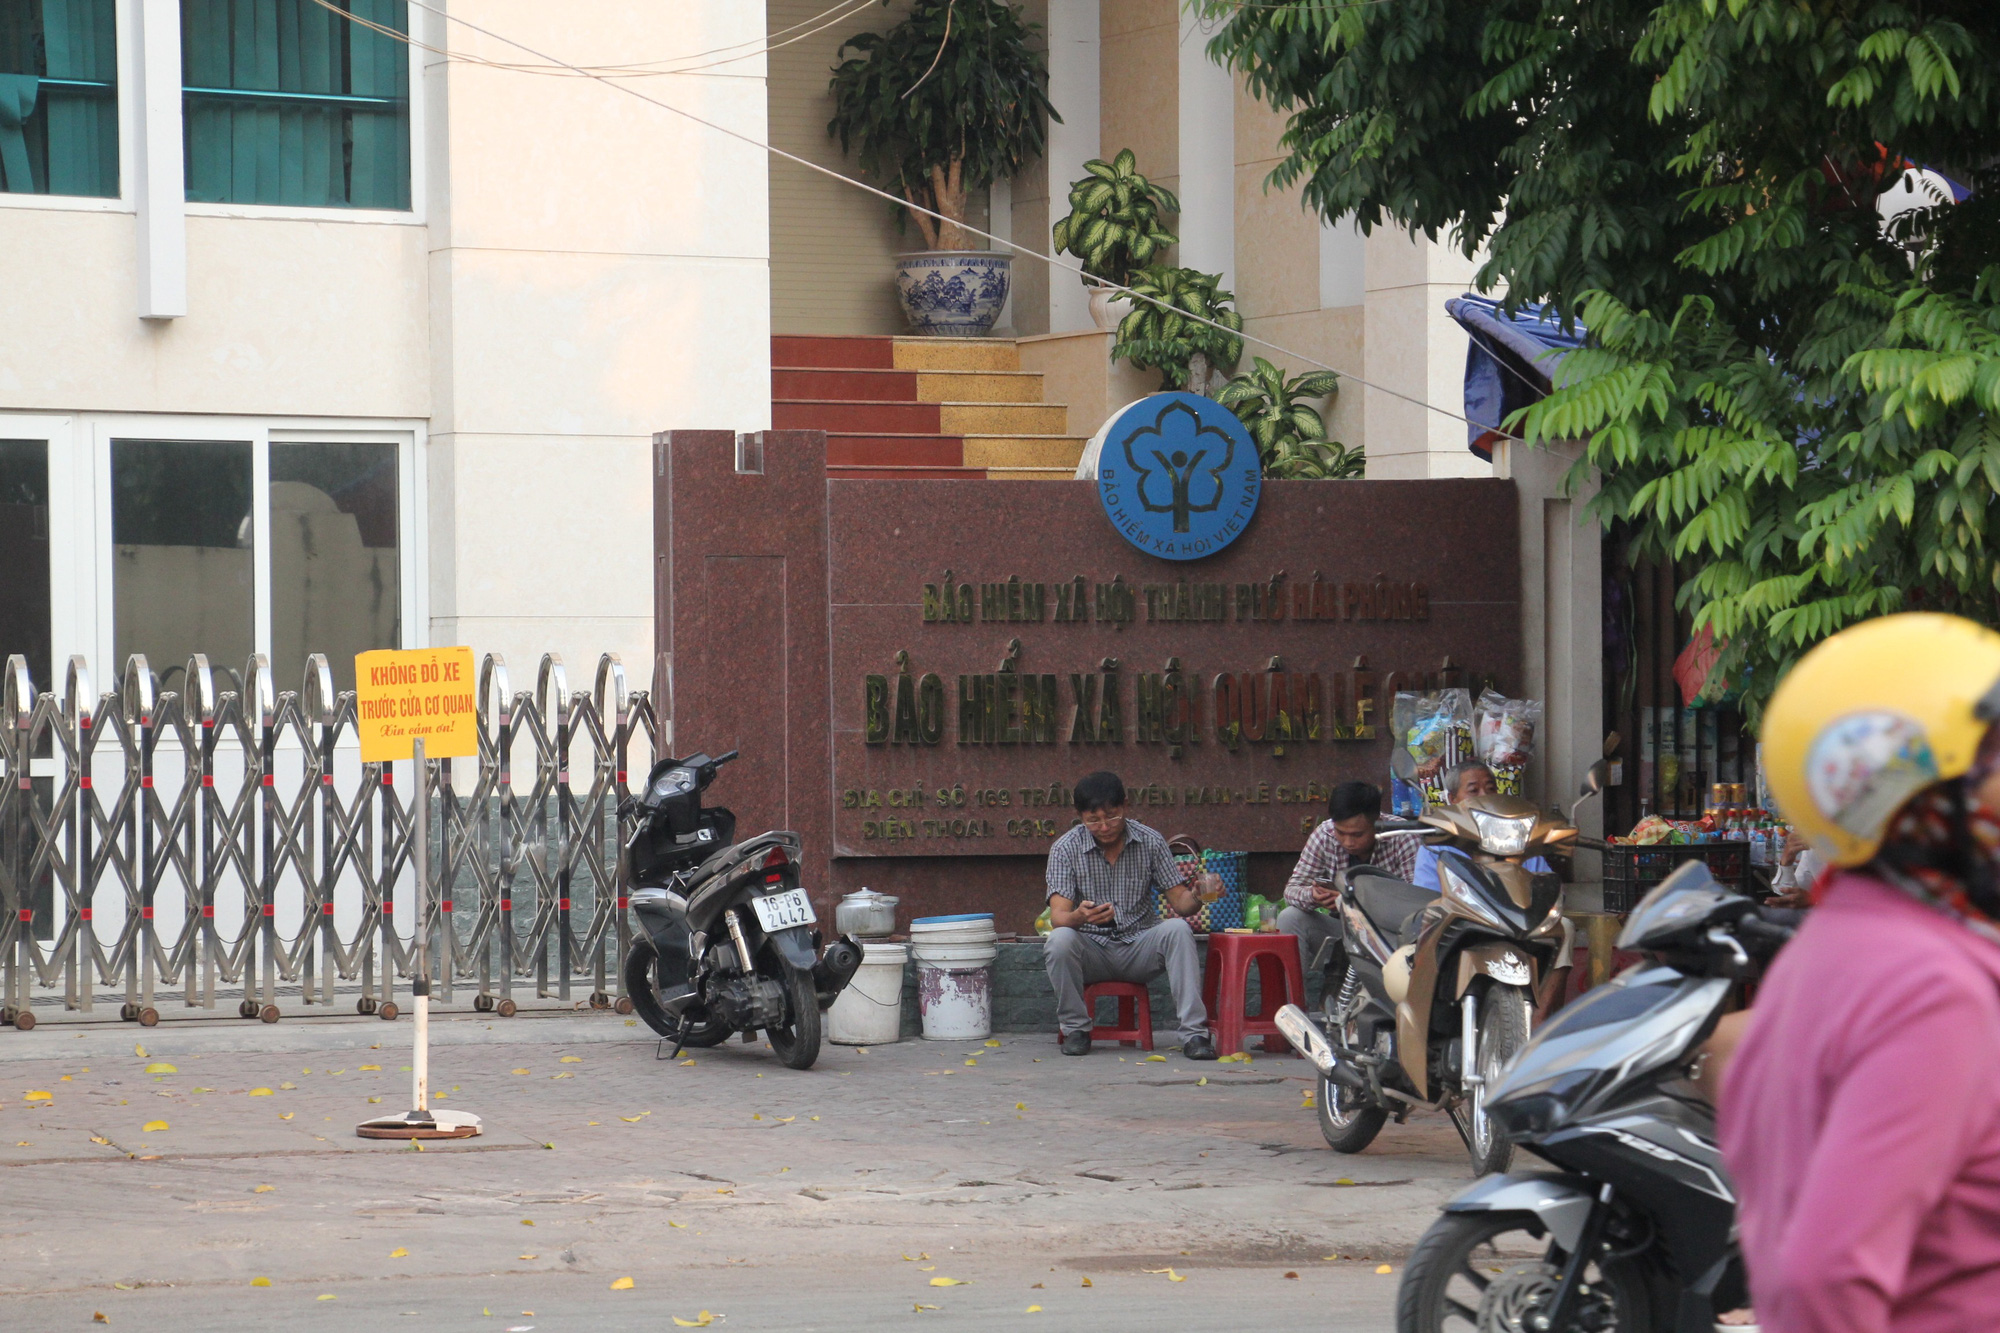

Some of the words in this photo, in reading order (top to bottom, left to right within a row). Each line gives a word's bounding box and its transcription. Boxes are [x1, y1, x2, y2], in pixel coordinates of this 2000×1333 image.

[1103, 469, 1120, 506] BẢO
[1213, 509, 1245, 543] VIỆT
[1240, 469, 1257, 508] NAM
[923, 569, 973, 622] BẢO
[1053, 574, 1088, 622] XÃ
[1095, 574, 1136, 631] HỘI
[1291, 569, 1336, 620] HẢI
[371, 661, 417, 686] KHÔNG
[421, 655, 439, 683] ĐỖ
[443, 662, 460, 682] XE
[361, 693, 397, 720] TRƯỚC
[400, 689, 422, 717] CỬA
[425, 694, 440, 716] CƠ
[443, 693, 473, 716] QUAN
[866, 650, 943, 743] BẢO
[957, 638, 1056, 743] HIỂM
[1068, 656, 1124, 742] XÃ
[1136, 656, 1200, 758] HỘI
[1212, 655, 1321, 756] QUẬN
[1333, 655, 1376, 740] LÊ
[380, 724, 405, 737] Xin
[843, 788, 882, 813] ĐỊA
[974, 788, 1010, 807] 169
[863, 815, 914, 844] ĐIỆN
[1006, 818, 1056, 837] 0313
[763, 893, 801, 912] 16-P6
[768, 908, 807, 928] 2442
